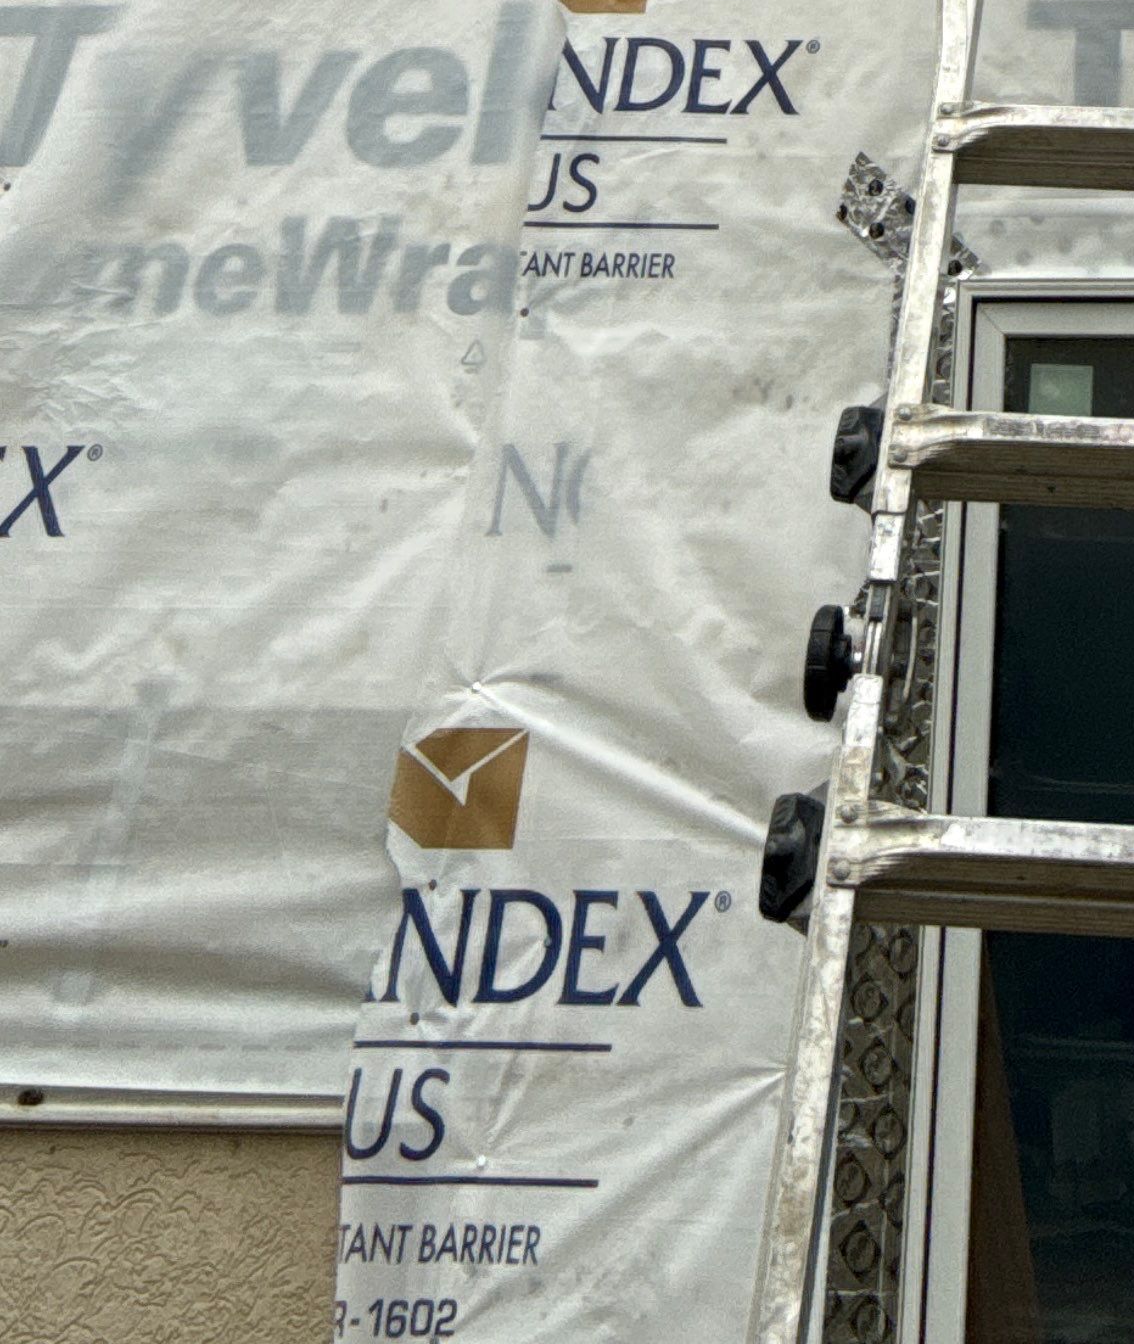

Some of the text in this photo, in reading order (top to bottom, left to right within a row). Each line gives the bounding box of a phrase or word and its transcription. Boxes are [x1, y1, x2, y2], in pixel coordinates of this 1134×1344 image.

[519, 250, 675, 279] ANT BARRIER
[345, 1068, 450, 1161] US
[418, 1223, 541, 1265] BARRIER
